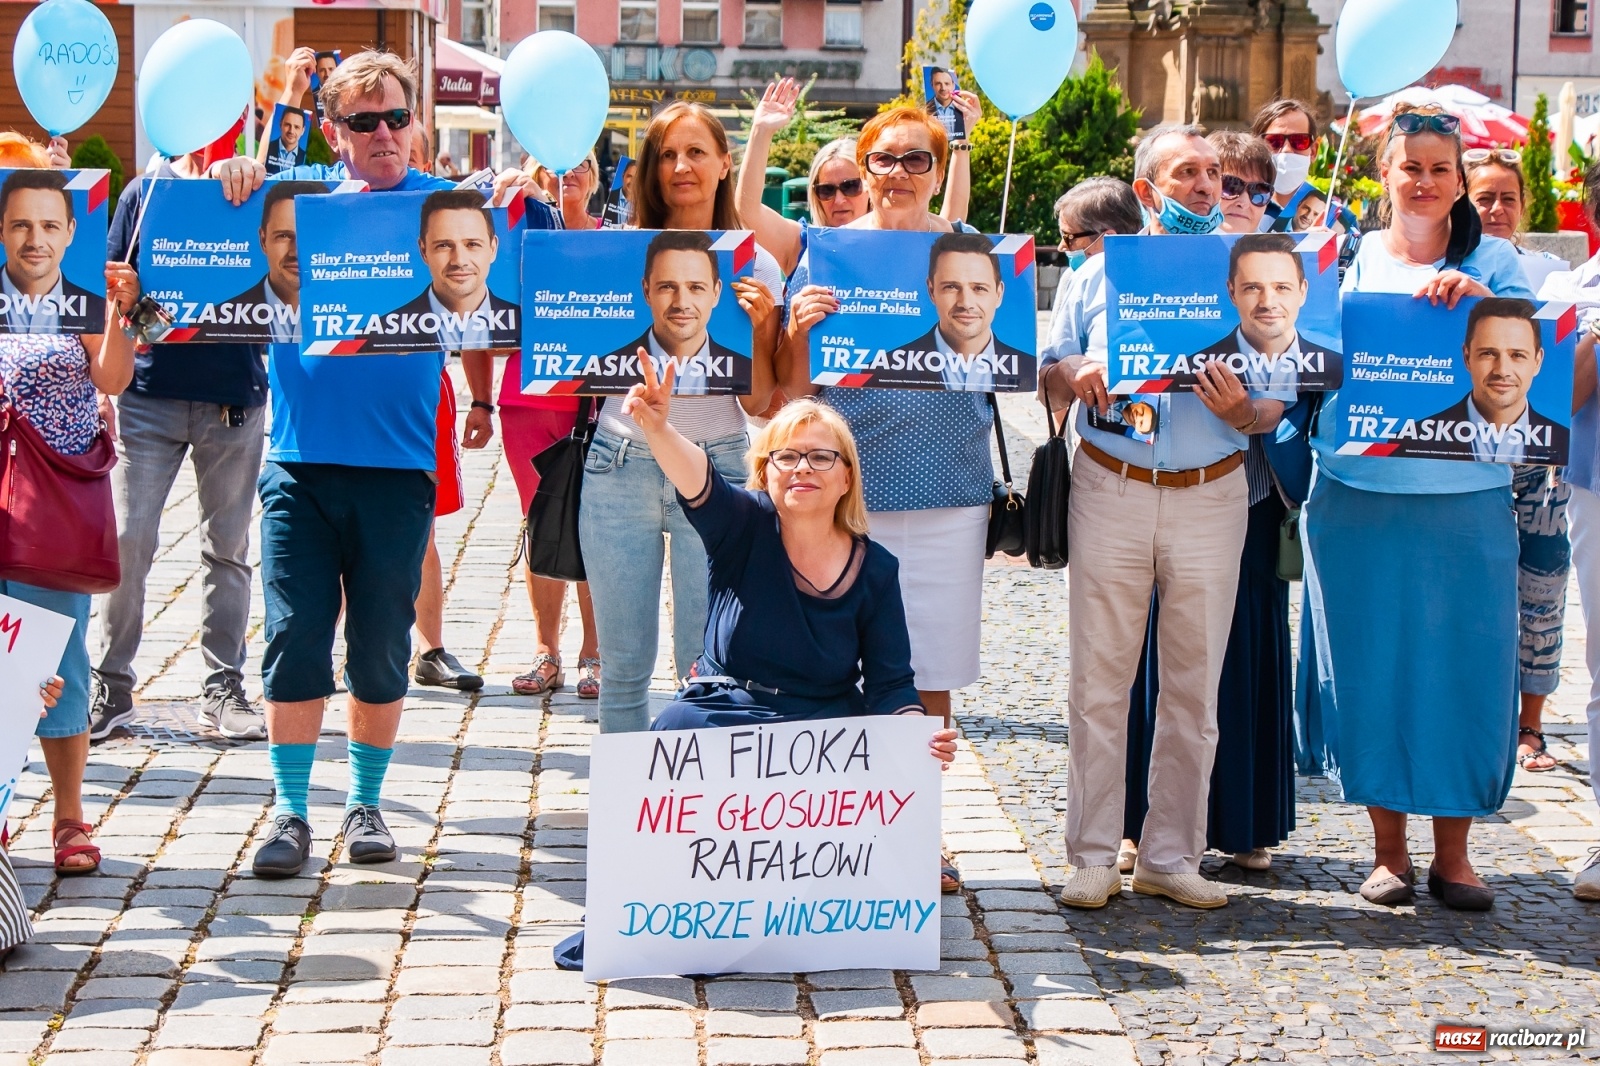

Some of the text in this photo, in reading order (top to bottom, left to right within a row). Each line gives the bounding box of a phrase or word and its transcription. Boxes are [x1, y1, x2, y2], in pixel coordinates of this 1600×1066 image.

[440, 76, 472, 92] Italia
[152, 238, 249, 252] Silny Prezydent
[152, 254, 251, 267] Wspólna Polska
[311, 251, 410, 266] Silny Prezydent
[311, 266, 413, 281] Wspólna Polska
[151, 290, 184, 300] RAFAŁ
[534, 291, 633, 305] Silny Prezydent
[855, 287, 918, 301] Prezydent
[1119, 293, 1218, 307] Silny Prezydent
[161, 302, 301, 325] RZASKOW
[313, 303, 347, 314] RAFAŁ
[534, 306, 635, 320] Wspólna Polska
[836, 302, 921, 315] pólna Polska
[1119, 307, 1222, 321] Wspólna Polska
[312, 309, 516, 337] TRZASKOWSKI
[533, 343, 567, 353] RAFAŁ
[822, 336, 855, 347] RAFAŁ
[1119, 343, 1154, 353] RAFAŁ
[821, 347, 1019, 376] TRZASKOWSKI
[1352, 352, 1453, 369] Silny Prezydent
[1352, 368, 1454, 383] Wspólna Polska
[1349, 404, 1384, 415] RAFAŁ
[1348, 416, 1553, 447] TRZASKOWSKI
[648, 732, 704, 781] NA
[717, 789, 915, 831] GŁOSUJEMY
[618, 899, 755, 939] DOBRZE
